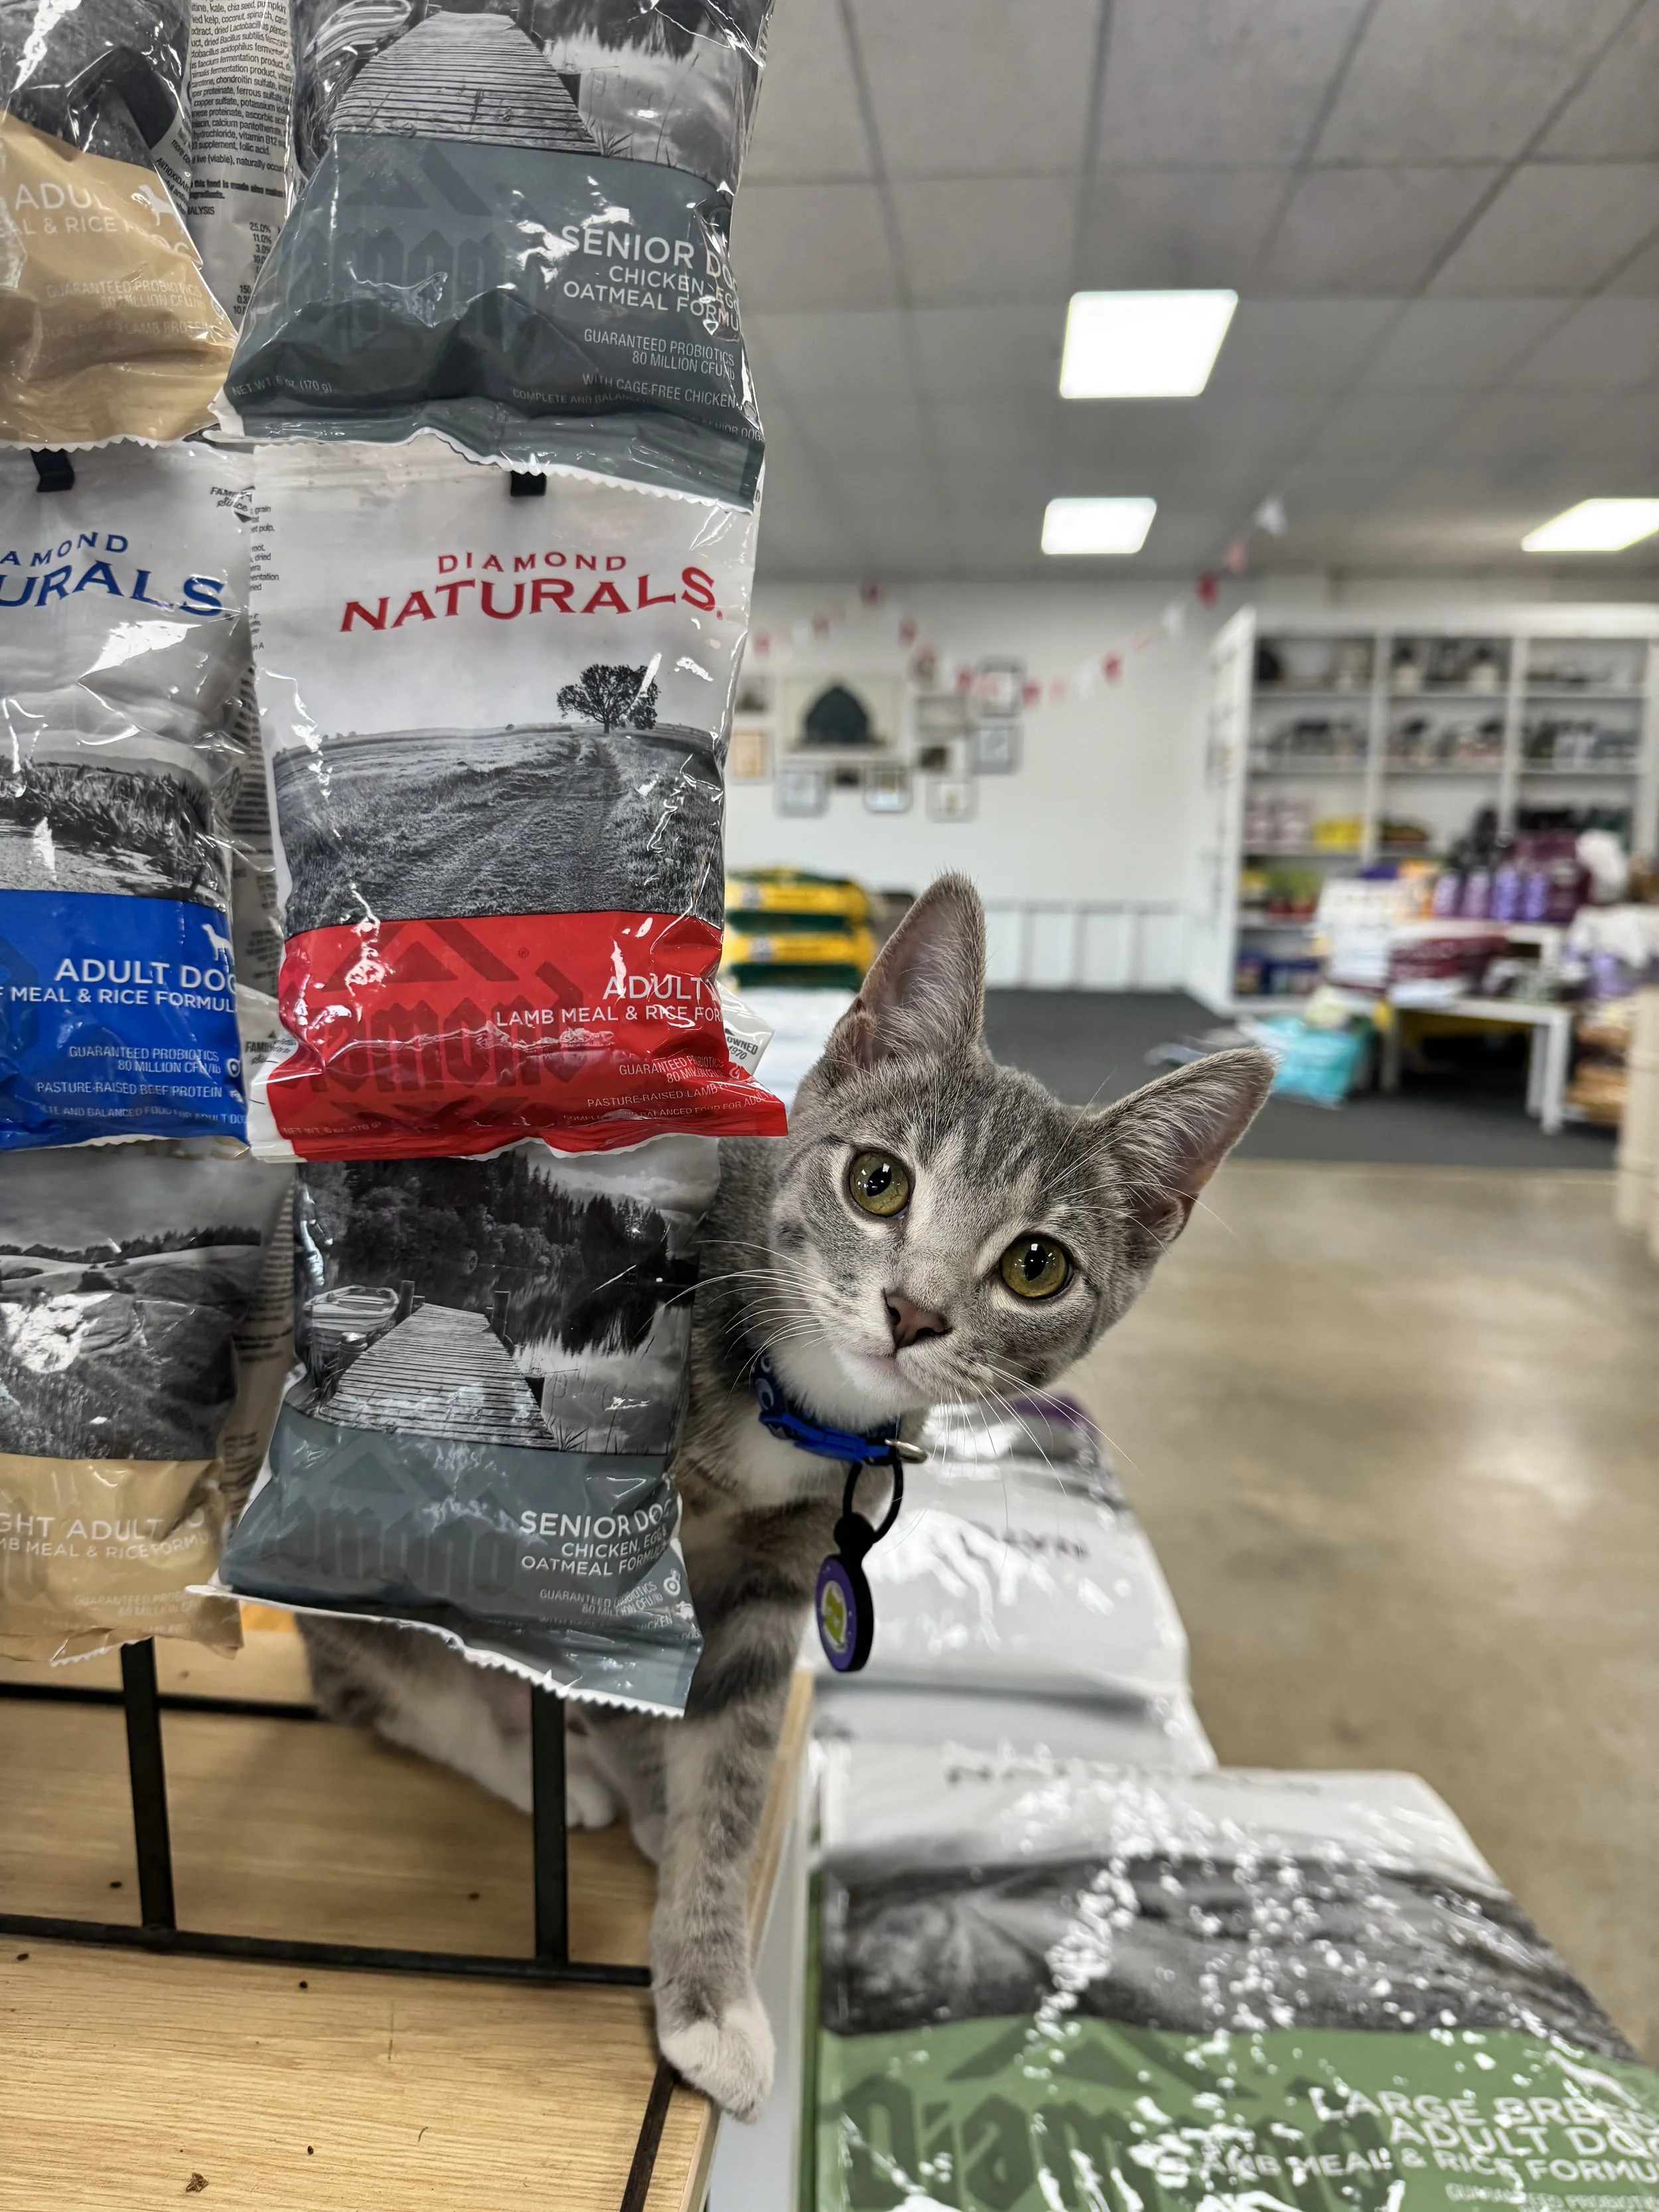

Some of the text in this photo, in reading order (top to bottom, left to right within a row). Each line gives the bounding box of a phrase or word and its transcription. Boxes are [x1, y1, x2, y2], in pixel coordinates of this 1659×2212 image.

[216, 76, 252, 84] chondroitin
[236, 86, 261, 97] ferrous
[239, 132, 264, 143] vitamin
[44, 216, 57, 234] &
[65, 216, 118, 234] RICE
[561, 225, 695, 269] SENIOR
[563, 281, 668, 311] OATMEAL
[585, 329, 735, 366] GUARANTEED PROBIOTICS
[632, 351, 697, 373] 80 MILLION
[232, 384, 252, 396] NET
[582, 374, 613, 387] WITH
[616, 379, 682, 400] CAGE-FREE
[0, 532, 129, 567] AMOND
[438, 551, 627, 575] DIAMOND
[339, 565, 717, 632] NATURALS
[54, 958, 171, 986] ADULT
[11, 986, 71, 1003] MEAL
[77, 988, 92, 1003] &
[98, 989, 149, 1005] RICE
[603, 975, 702, 1000] ADULT
[496, 1004, 724, 1027] LAMB MEAL & RICE FOR
[69, 1046, 220, 1062] GUARANTEED PROBIOTICS
[117, 1061, 133, 1072] 80
[135, 1062, 181, 1073] MILLION
[618, 1057, 687, 1076] GUARANTEED
[667, 1071, 680, 1083] 80
[36, 1081, 223, 1098] PASTURE-RAISED BEEF PROTEIN
[587, 1090, 684, 1108] PASTURE-RAISED
[687, 1082, 718, 1098] LAMB
[723, 1102, 742, 1111] FOR
[66, 1518, 164, 1542] ADULT
[520, 1510, 631, 1539] SENIOR
[26, 1540, 80, 1557] MEAL
[86, 1544, 98, 1558] &
[106, 1543, 150, 1560] RICE
[561, 1538, 641, 1559] CHICKEN,
[522, 1556, 613, 1576] OATMEAL
[540, 1588, 611, 1608] GUARANTEED
[1308, 2087, 1486, 2125] LARGE
[1390, 2117, 1550, 2156] ADULT
[1401, 2148, 1428, 2169] &
